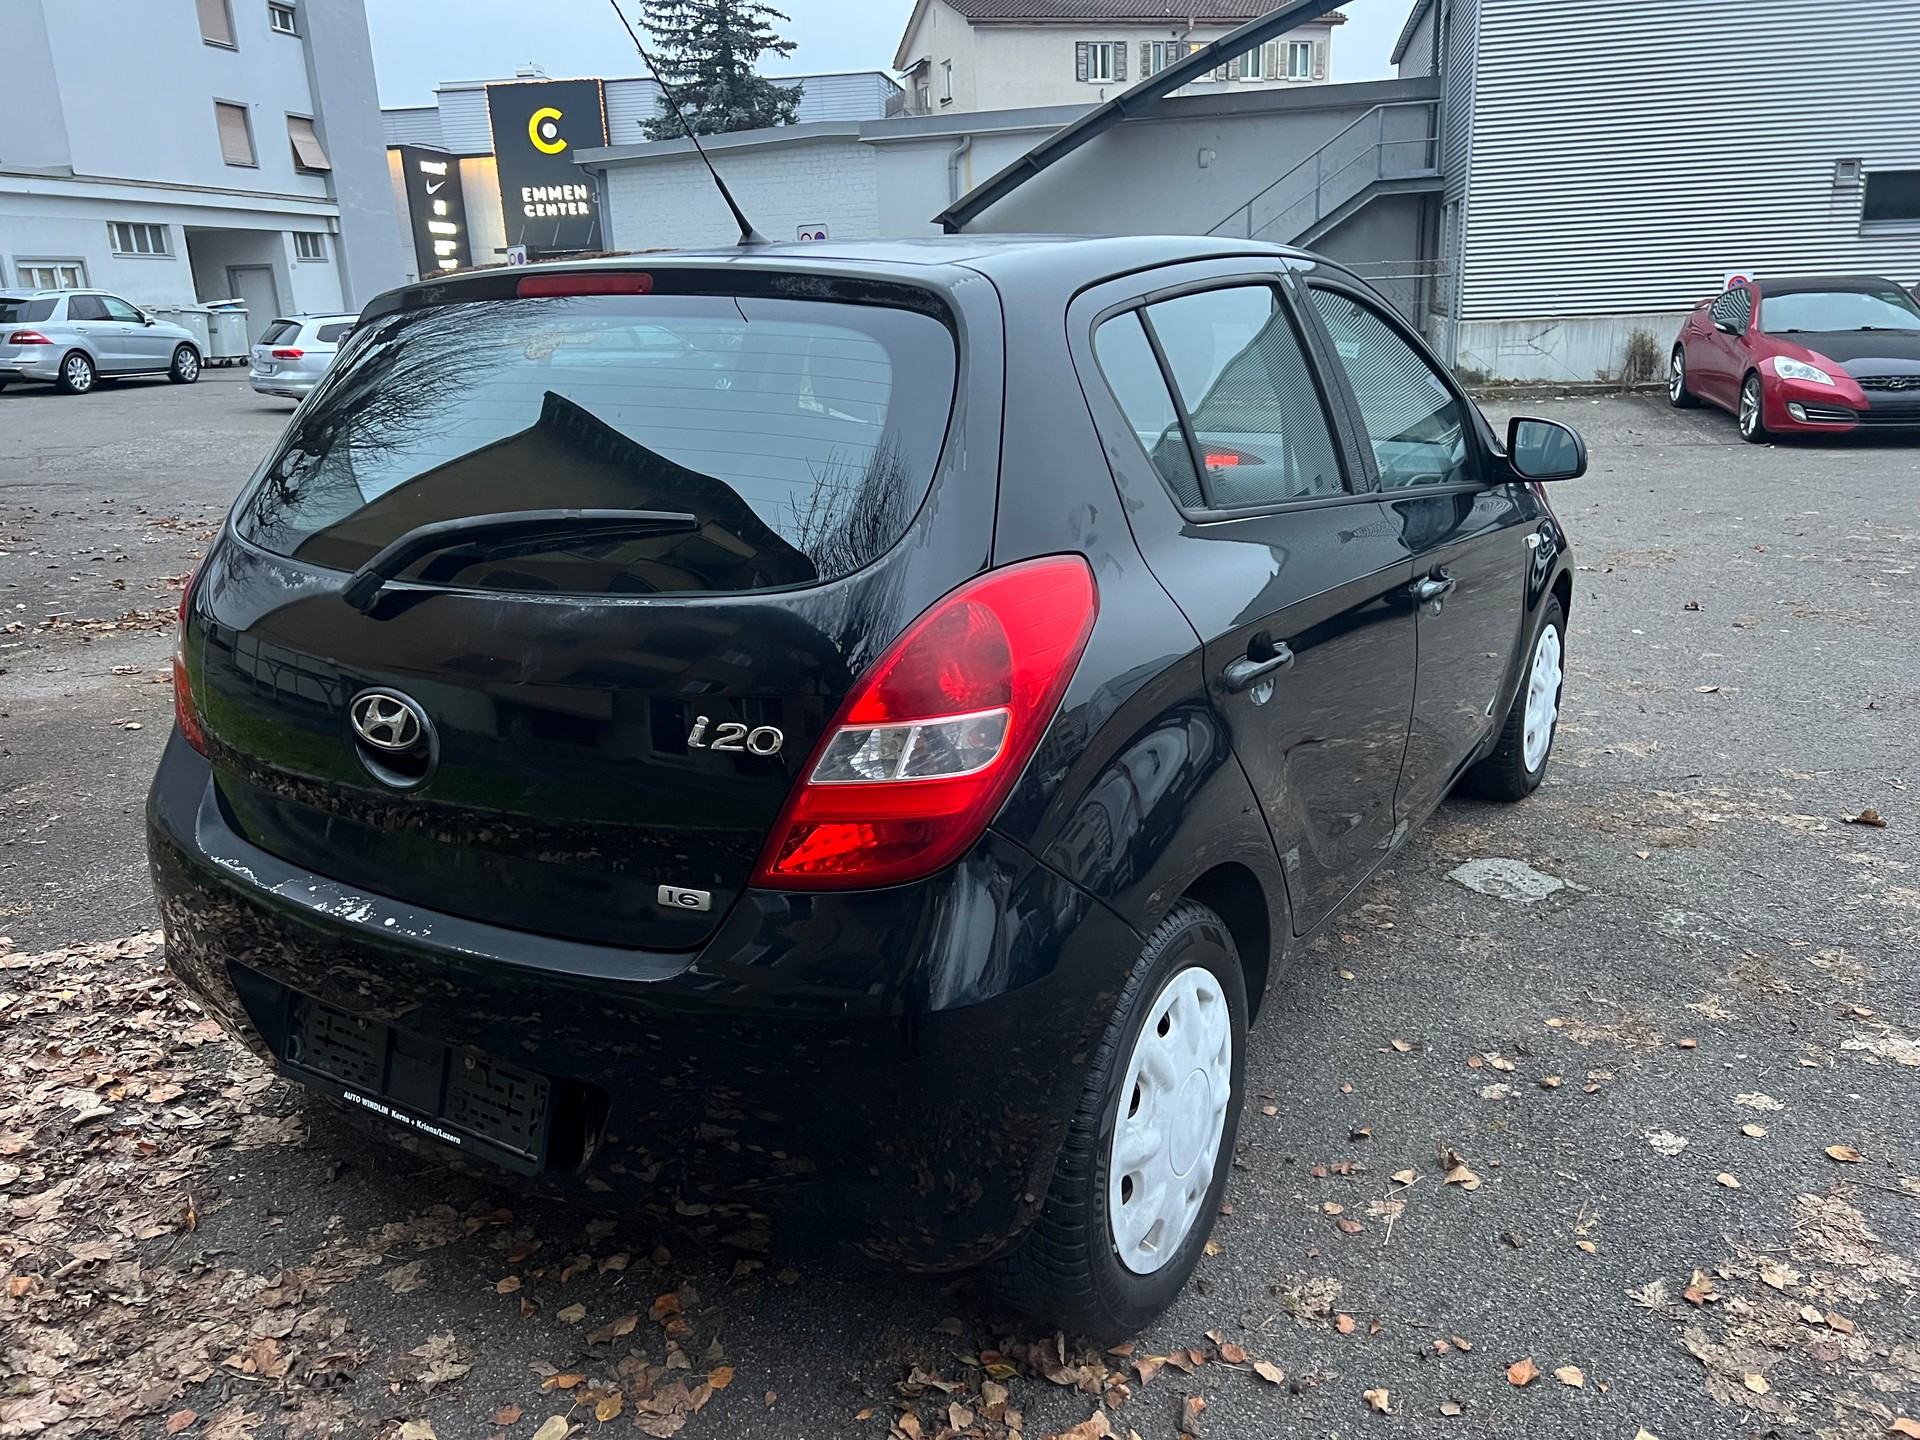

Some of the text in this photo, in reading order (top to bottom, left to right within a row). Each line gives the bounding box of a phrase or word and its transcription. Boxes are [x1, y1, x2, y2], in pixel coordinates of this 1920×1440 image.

[522, 184, 587, 202] EMMEN
[524, 202, 589, 217] CENTER
[687, 715, 784, 755] i20
[343, 1091, 361, 1103] AUTO
[361, 1097, 388, 1115] WINDLIN
